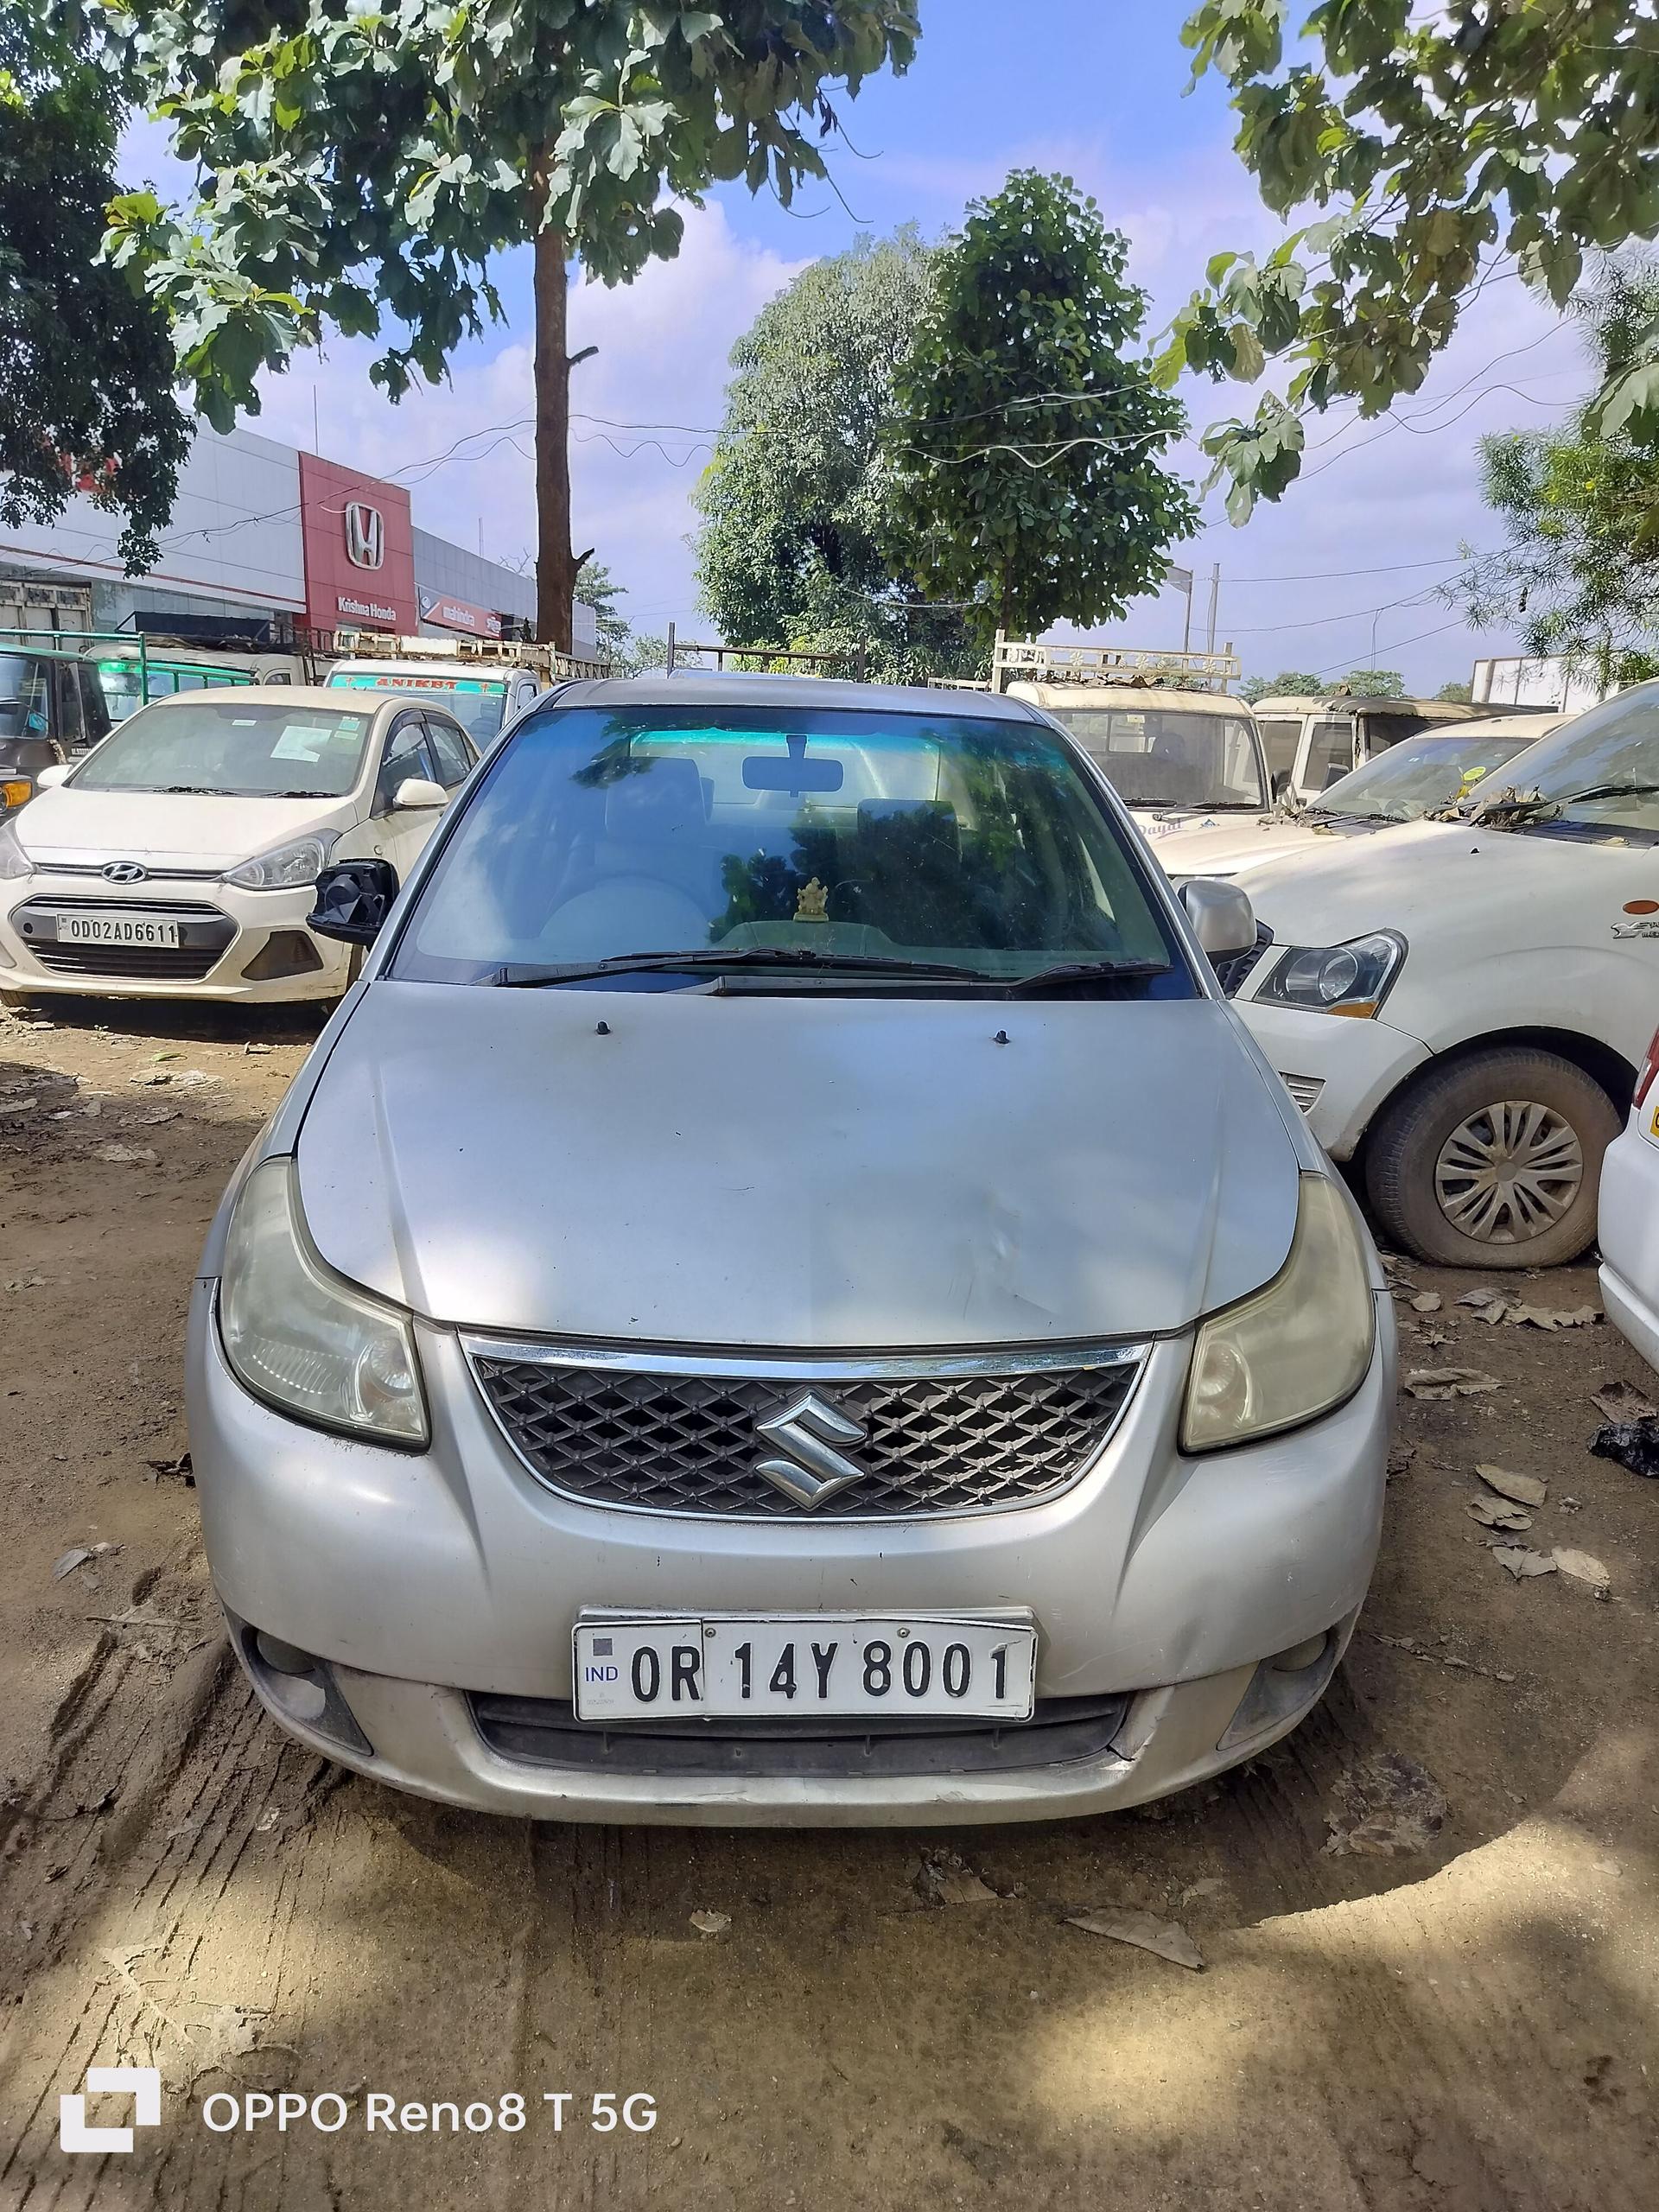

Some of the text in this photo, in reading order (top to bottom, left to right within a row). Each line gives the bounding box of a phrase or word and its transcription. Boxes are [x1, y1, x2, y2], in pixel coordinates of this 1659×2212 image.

[338, 596, 396, 621] Krishna Honda
[442, 606, 475, 626] mahindra
[71, 920, 175, 943] OD02AD6611
[585, 1640, 1010, 1703] IND OR 14Y 8001
